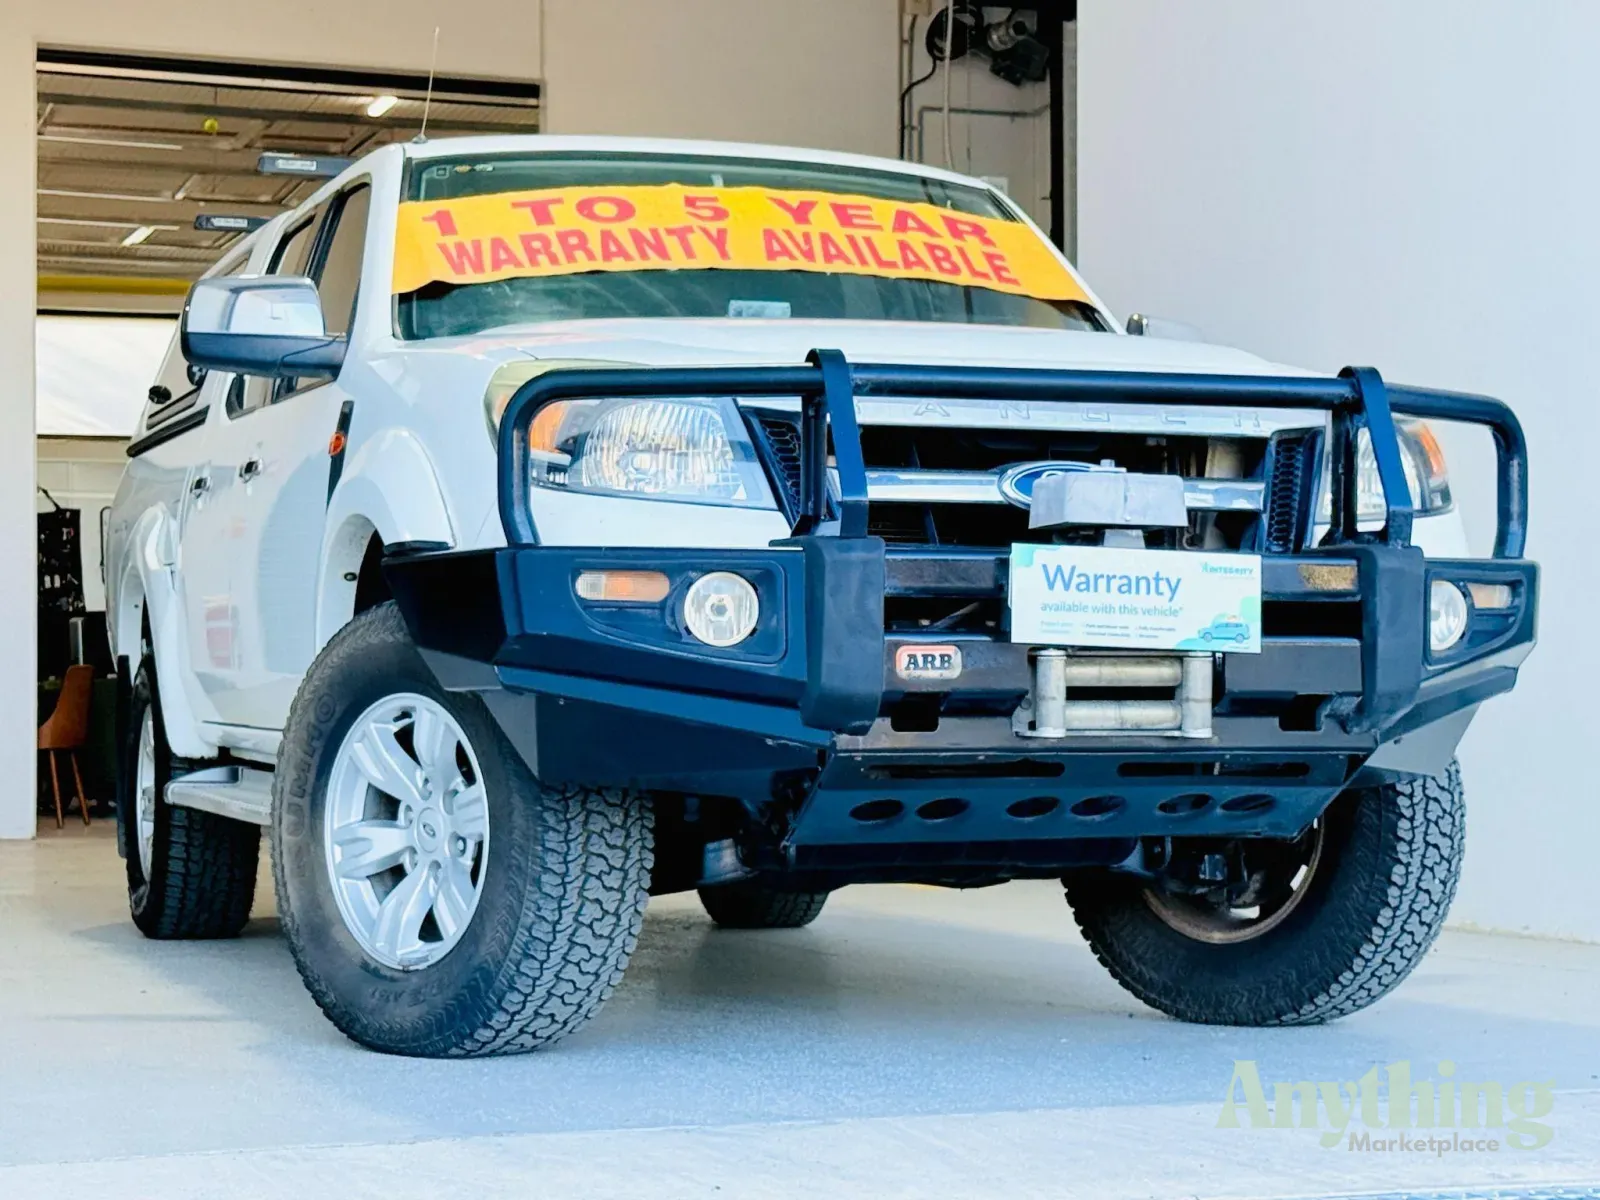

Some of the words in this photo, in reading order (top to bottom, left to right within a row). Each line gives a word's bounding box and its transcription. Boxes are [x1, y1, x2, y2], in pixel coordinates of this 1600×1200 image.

[422, 209, 459, 237] 1
[511, 195, 637, 227] TO
[683, 194, 731, 222] 5
[766, 196, 998, 248] YEAR
[436, 224, 732, 276] WARRANTY
[762, 227, 1022, 287] AVAILABLE
[855, 401, 1261, 428] ANGER
[1041, 563, 1182, 602] Warranty
[1040, 602, 1089, 613] available
[1091, 603, 1116, 615] with
[1118, 603, 1139, 616] this
[905, 653, 953, 671] ARB
